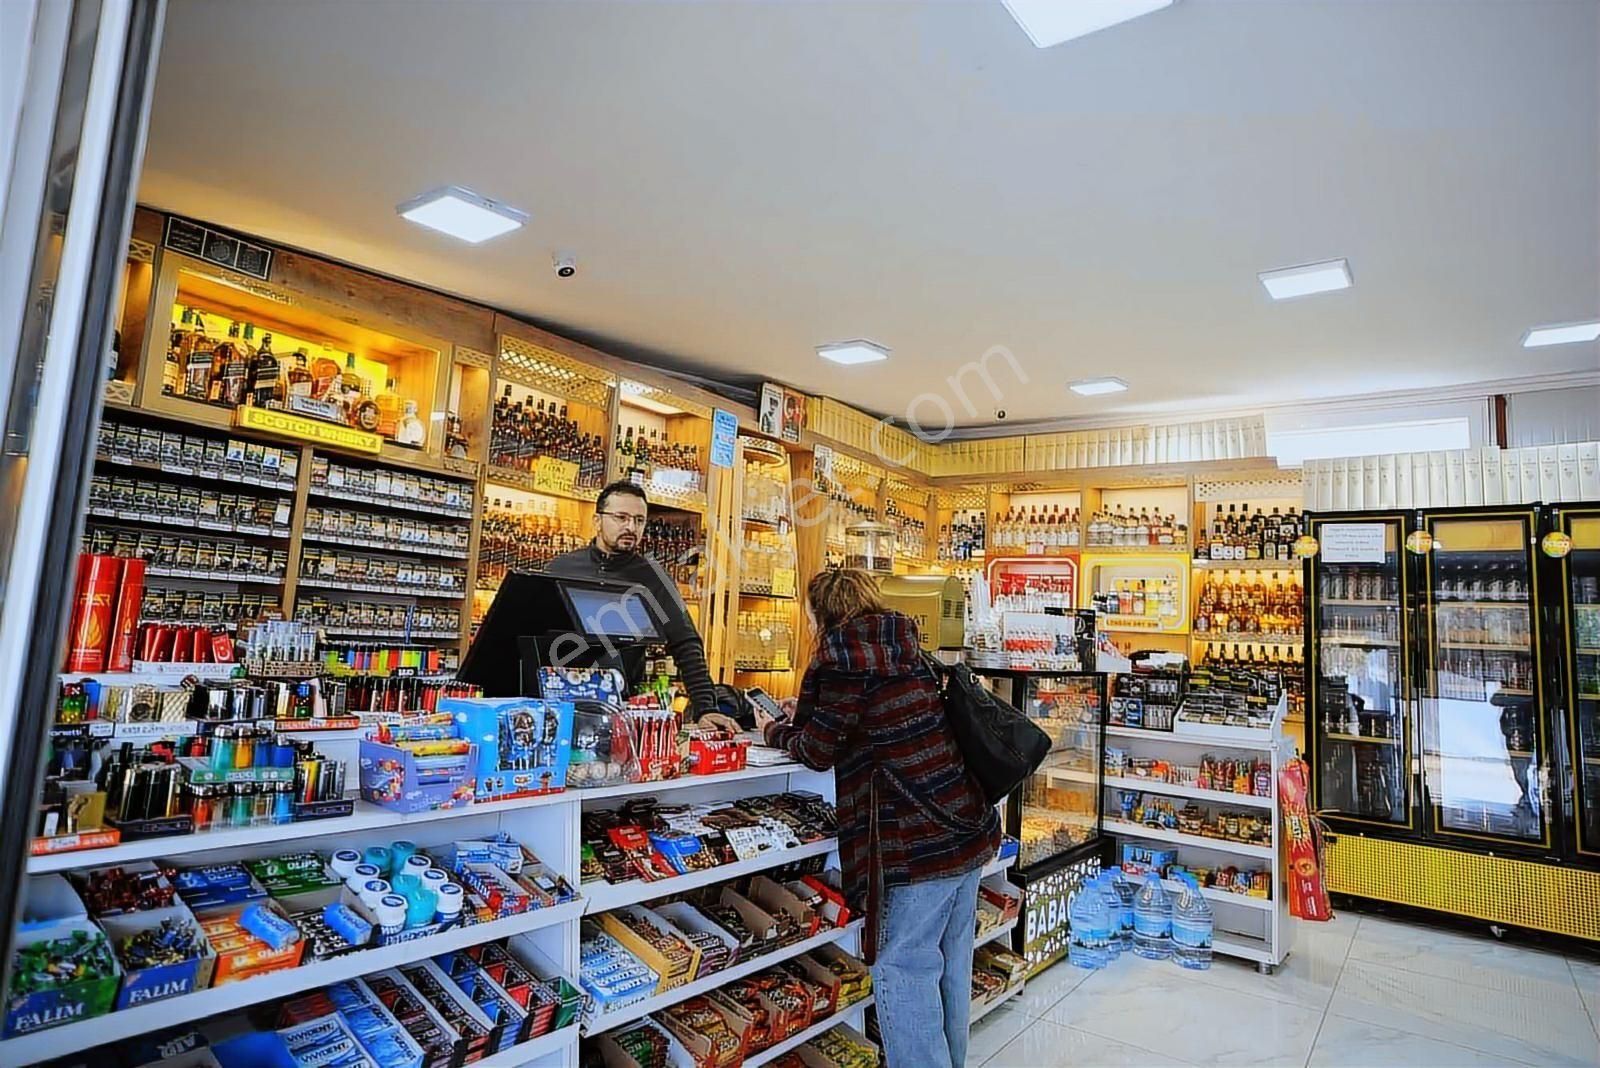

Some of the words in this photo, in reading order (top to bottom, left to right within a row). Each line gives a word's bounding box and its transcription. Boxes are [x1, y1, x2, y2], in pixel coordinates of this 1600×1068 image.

[252, 411, 316, 436] SCOTCH
[318, 426, 377, 447] WHISKY
[130, 978, 189, 1004] FALIM
[15, 1002, 85, 1031] FALIM
[287, 1020, 334, 1042] VIVIDENT
[301, 1042, 350, 1064] VIVIDENT
